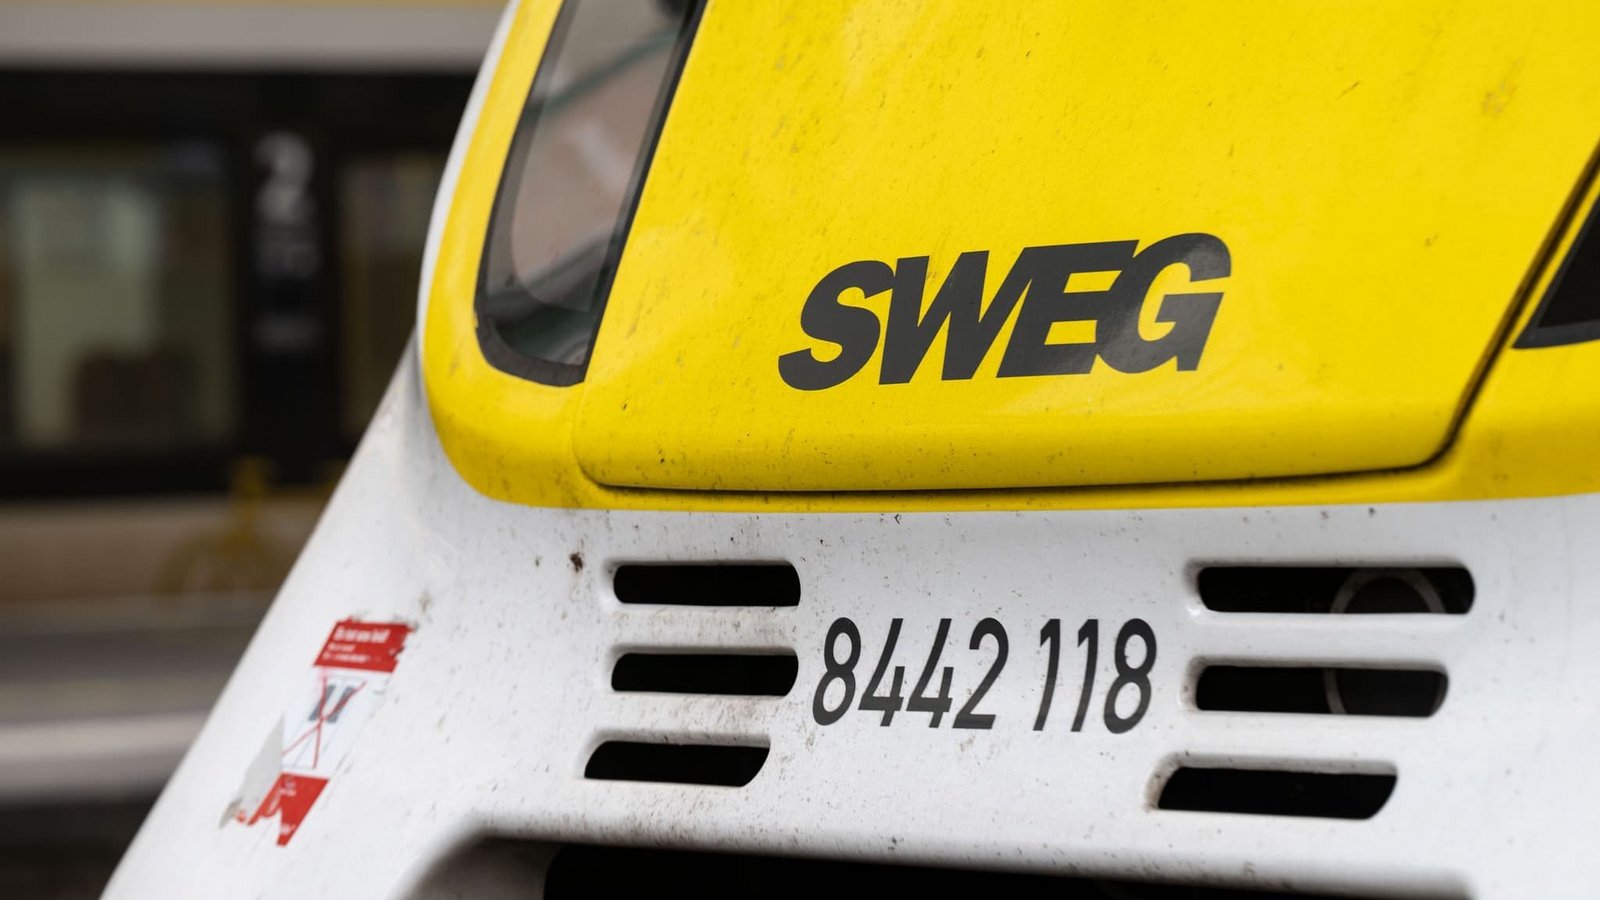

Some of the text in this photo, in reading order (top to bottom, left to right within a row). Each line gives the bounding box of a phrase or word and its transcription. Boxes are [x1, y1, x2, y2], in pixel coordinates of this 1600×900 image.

[778, 232, 1232, 391] SWEG
[812, 617, 1158, 735] 8442 118
